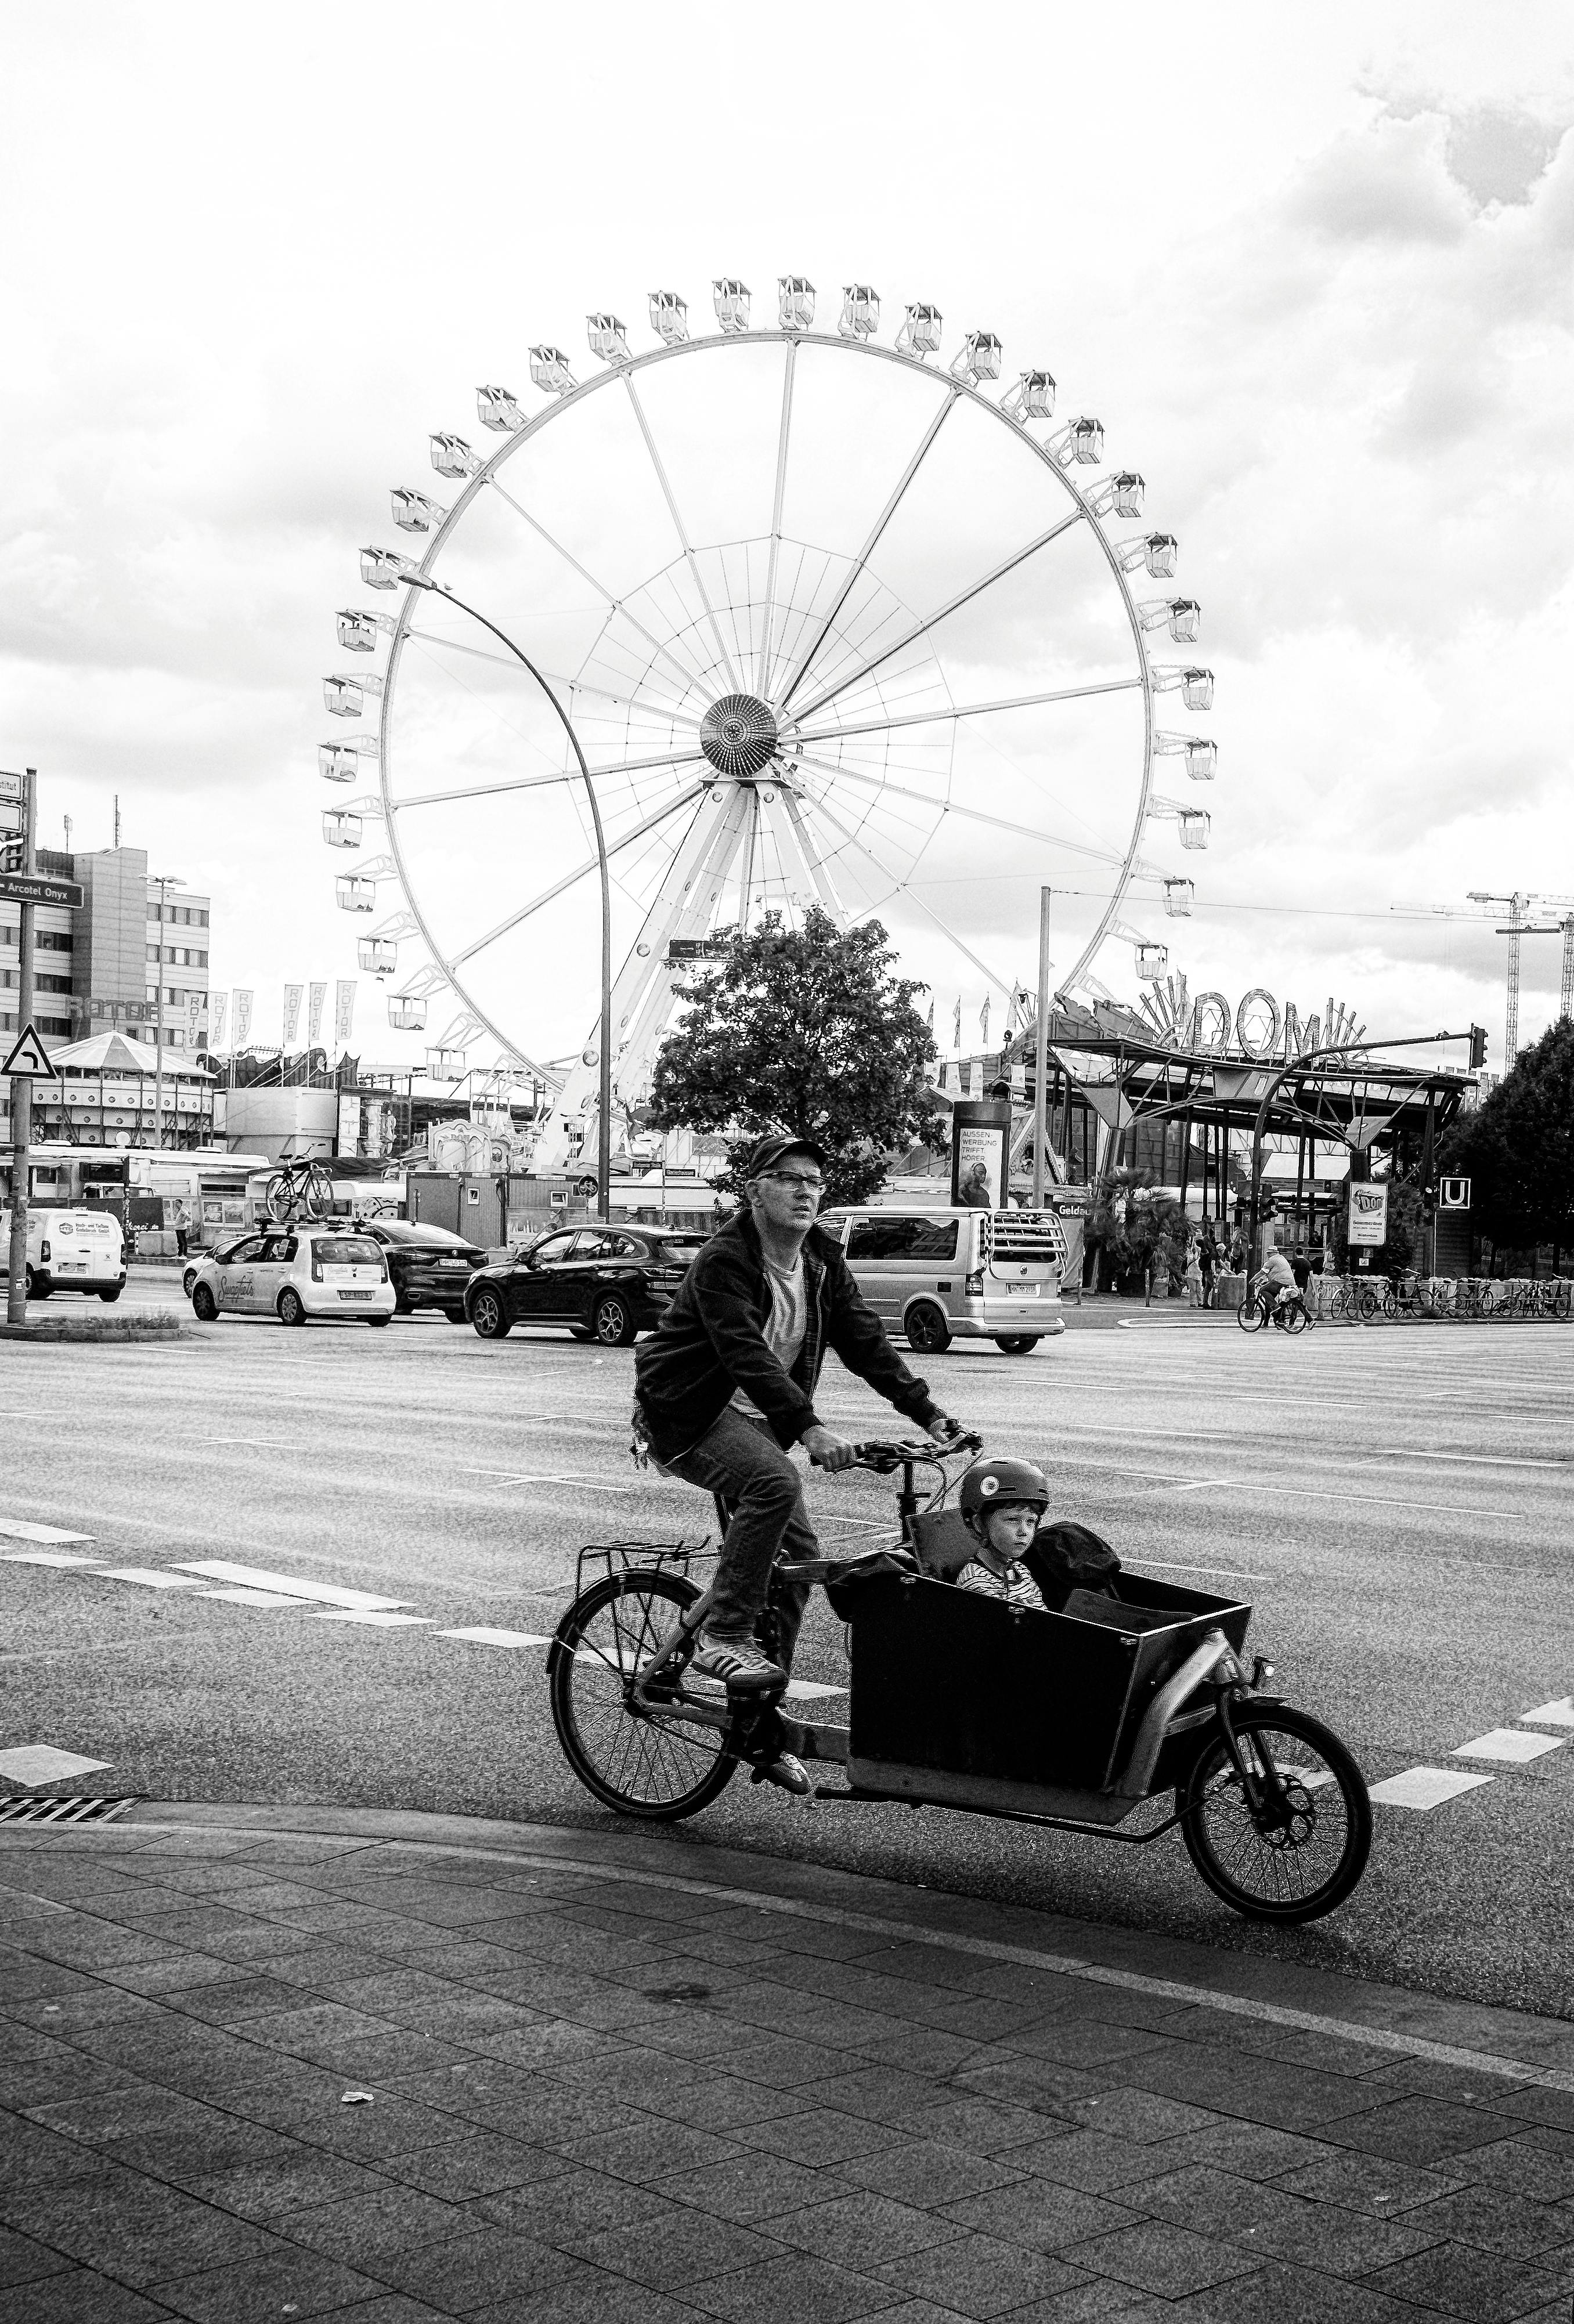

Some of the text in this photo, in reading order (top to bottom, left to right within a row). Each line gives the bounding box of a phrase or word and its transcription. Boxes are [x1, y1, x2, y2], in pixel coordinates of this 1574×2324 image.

[8, 883, 68, 900] Arcotel Onyx
[1193, 988, 1320, 1067] DOM
[1445, 1181, 1465, 1205] U
